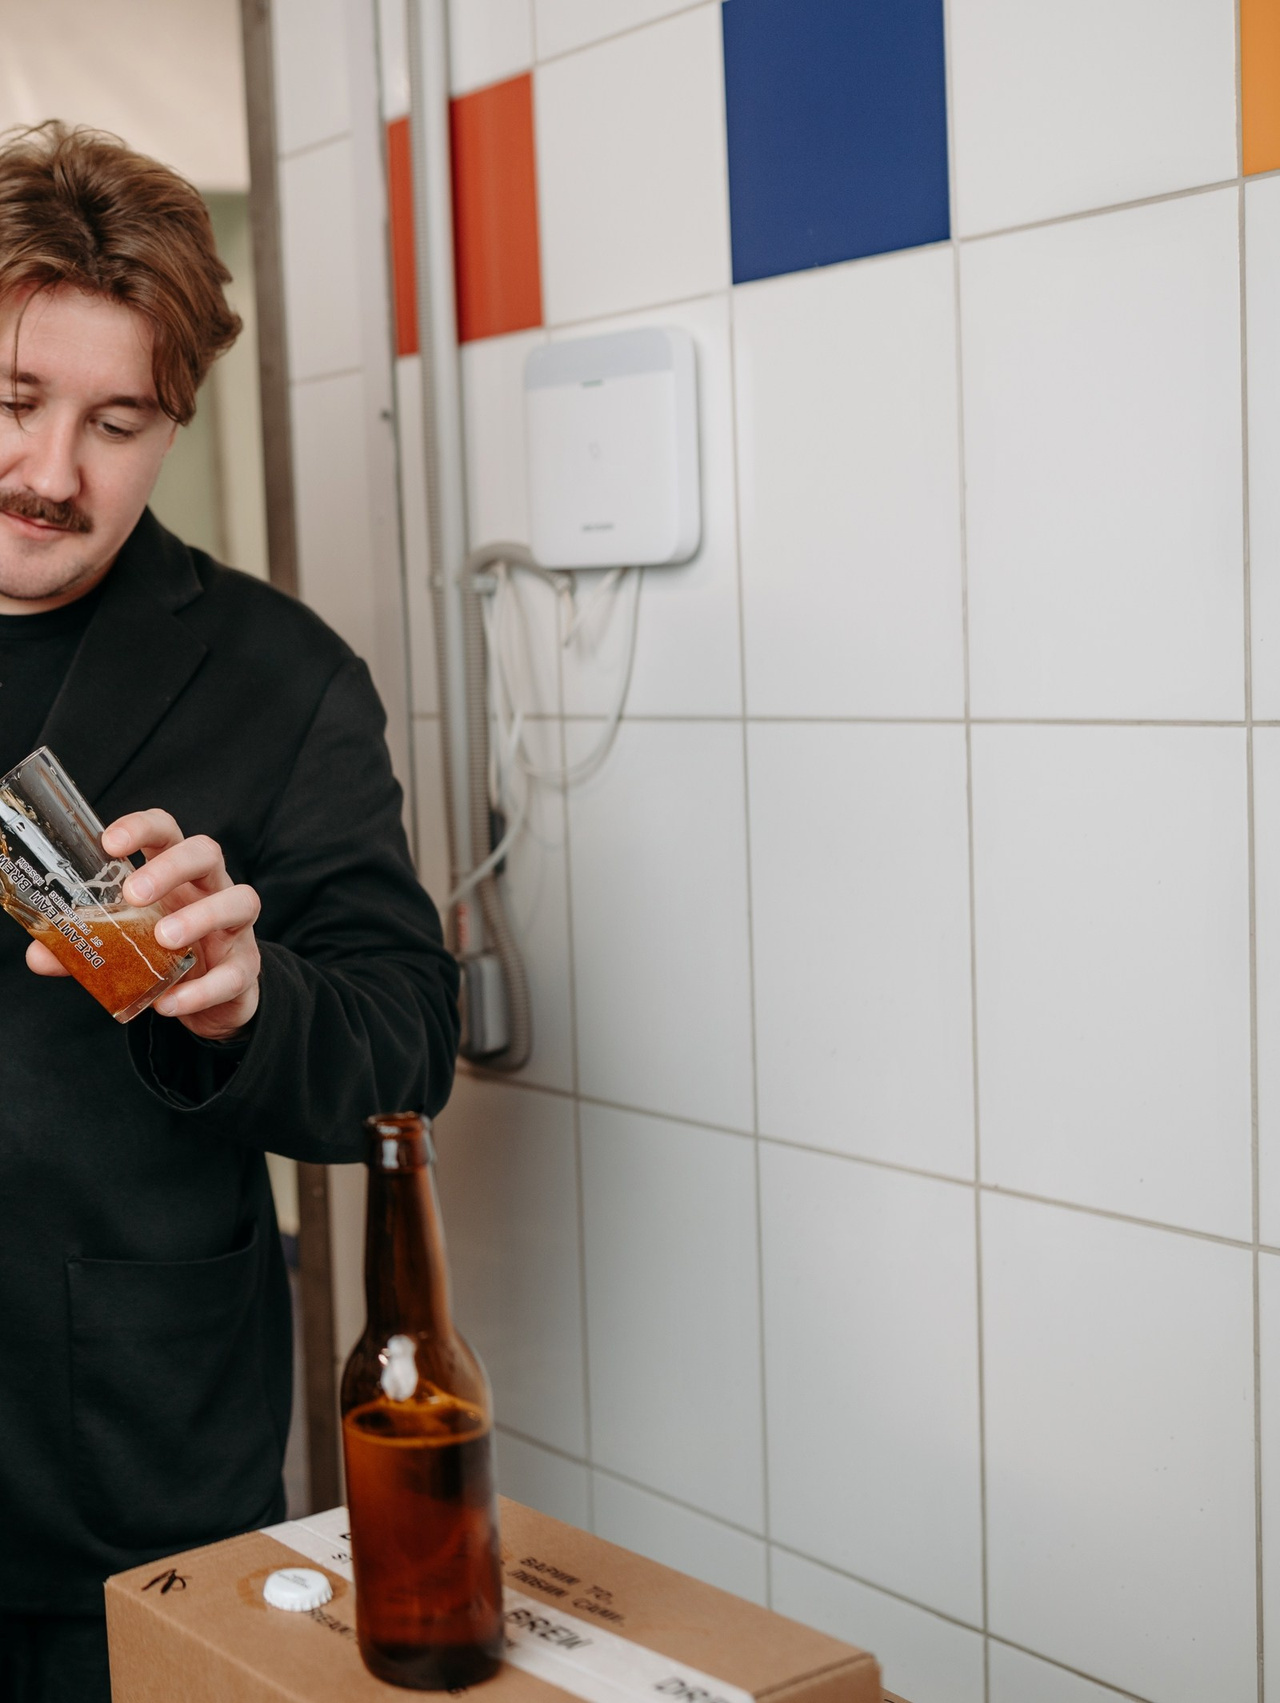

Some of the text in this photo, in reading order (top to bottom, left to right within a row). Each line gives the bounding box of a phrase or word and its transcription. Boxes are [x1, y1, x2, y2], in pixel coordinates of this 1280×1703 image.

[29, 890, 105, 969] DREAMTEAM
[48, 890, 91, 935] PETERSBURG
[90, 936, 103, 947] ST
[505, 1608, 594, 1650] BREW
